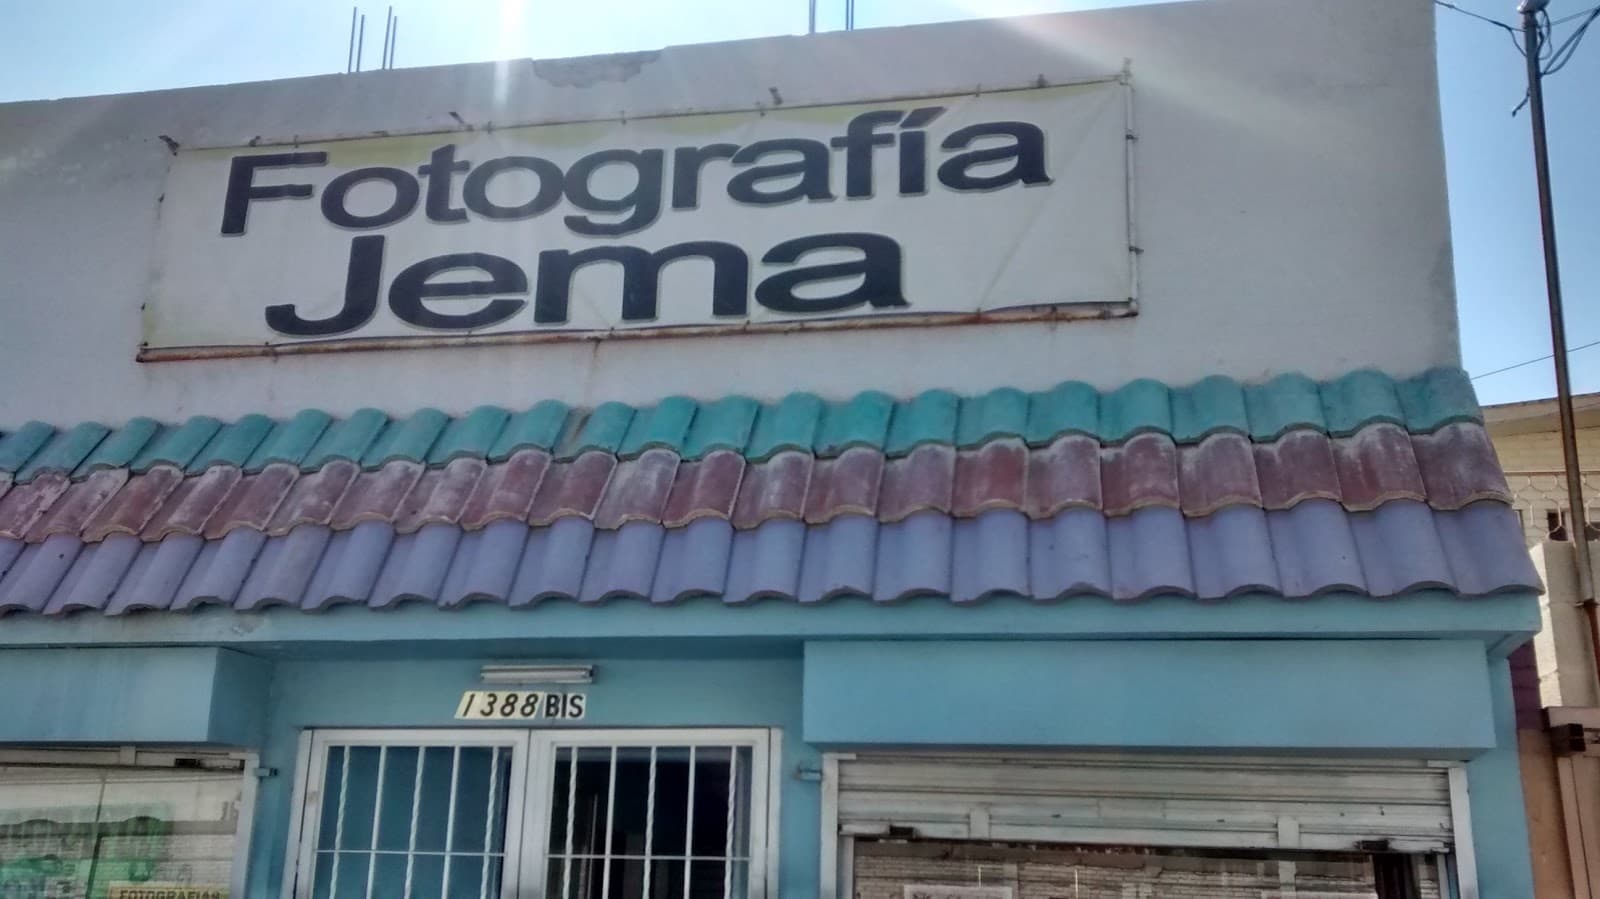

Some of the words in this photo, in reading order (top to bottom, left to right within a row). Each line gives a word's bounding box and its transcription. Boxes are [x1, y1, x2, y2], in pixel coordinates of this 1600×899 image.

[221, 107, 1052, 236] Fotografía
[265, 231, 909, 336] Jema
[463, 693, 539, 717] 1388
[545, 694, 584, 718] BIS
